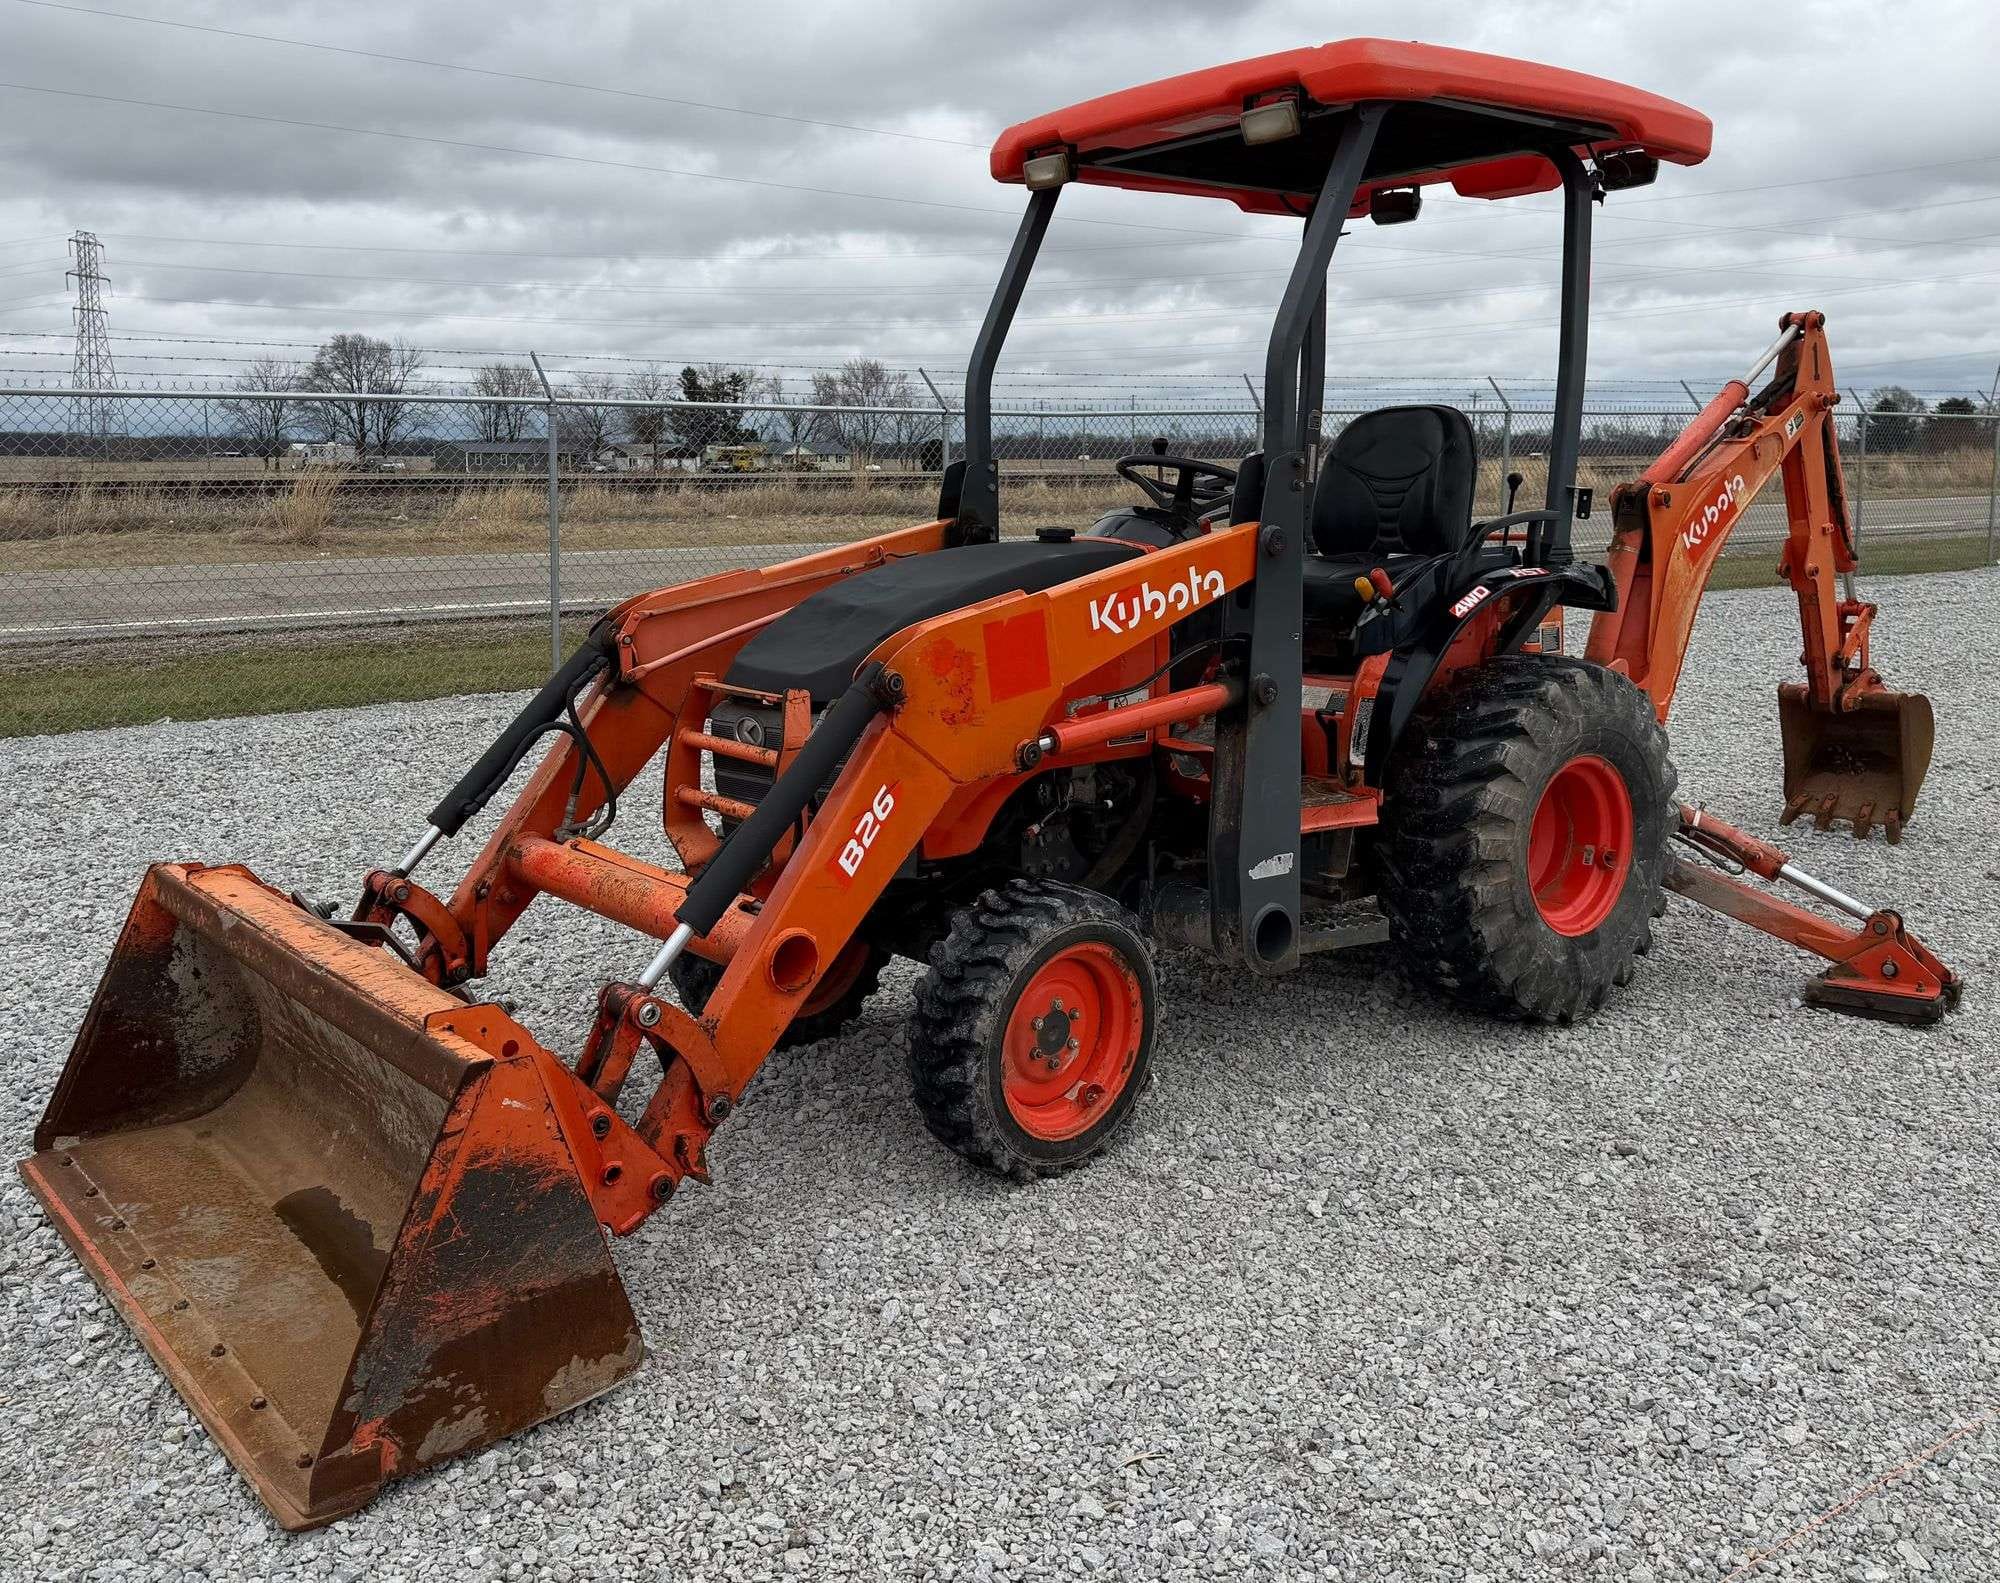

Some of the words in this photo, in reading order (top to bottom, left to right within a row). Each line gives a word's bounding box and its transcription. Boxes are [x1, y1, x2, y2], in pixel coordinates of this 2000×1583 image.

[1682, 475, 1746, 549] Kubota
[1089, 565, 1225, 634] Kubota
[1454, 585, 1491, 618] 4WD
[838, 784, 895, 877] B26
